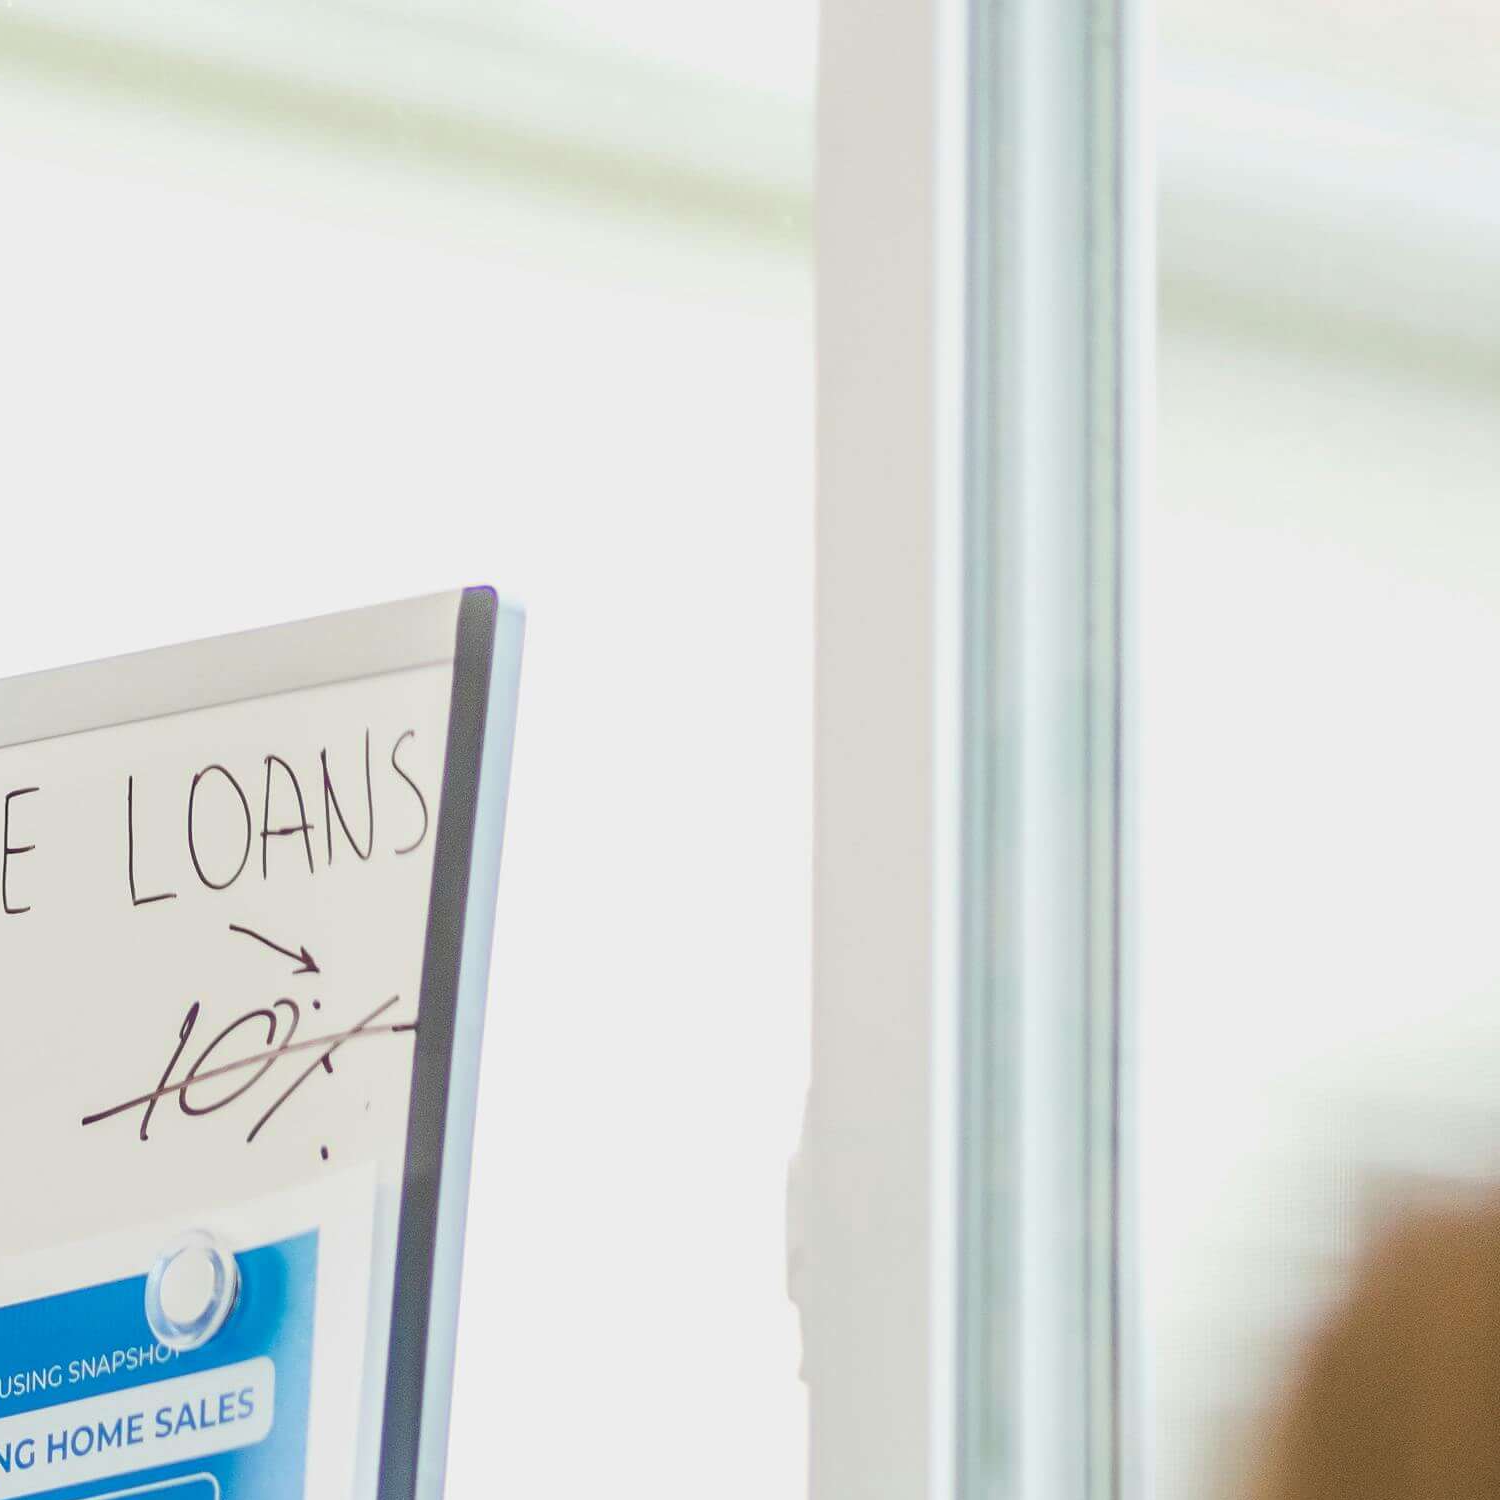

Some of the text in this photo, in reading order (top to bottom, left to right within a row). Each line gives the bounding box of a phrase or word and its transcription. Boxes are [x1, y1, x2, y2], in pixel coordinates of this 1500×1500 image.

[128, 728, 428, 906] LOANS
[46, 1414, 144, 1461] HOME
[154, 1387, 255, 1439] SALES
